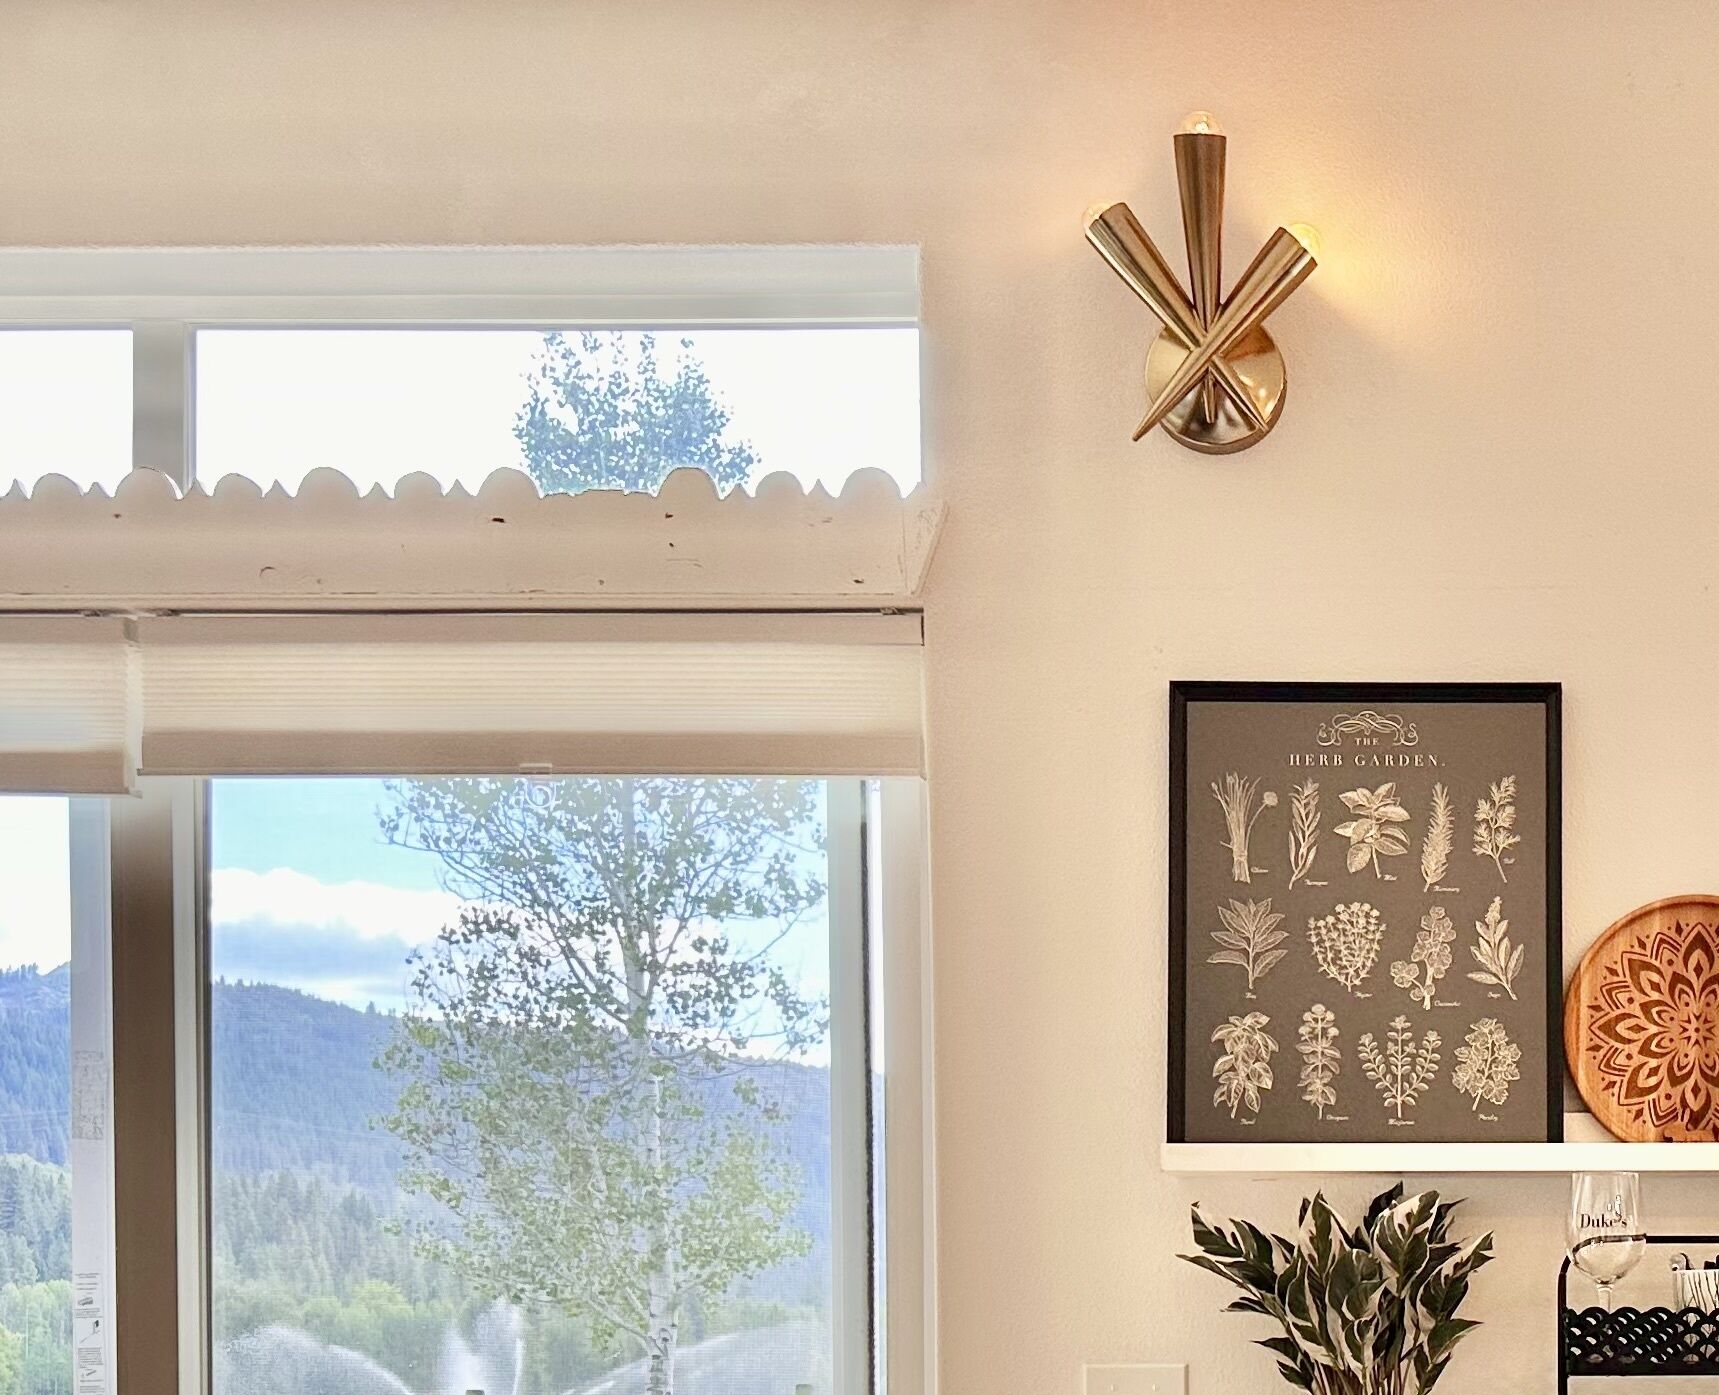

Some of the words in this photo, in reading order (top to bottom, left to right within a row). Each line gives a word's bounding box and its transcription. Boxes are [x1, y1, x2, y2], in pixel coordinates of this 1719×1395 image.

[1355, 737, 1380, 746] THE
[1289, 754, 1343, 767] HERB
[1354, 754, 1446, 767] GARDEN.
